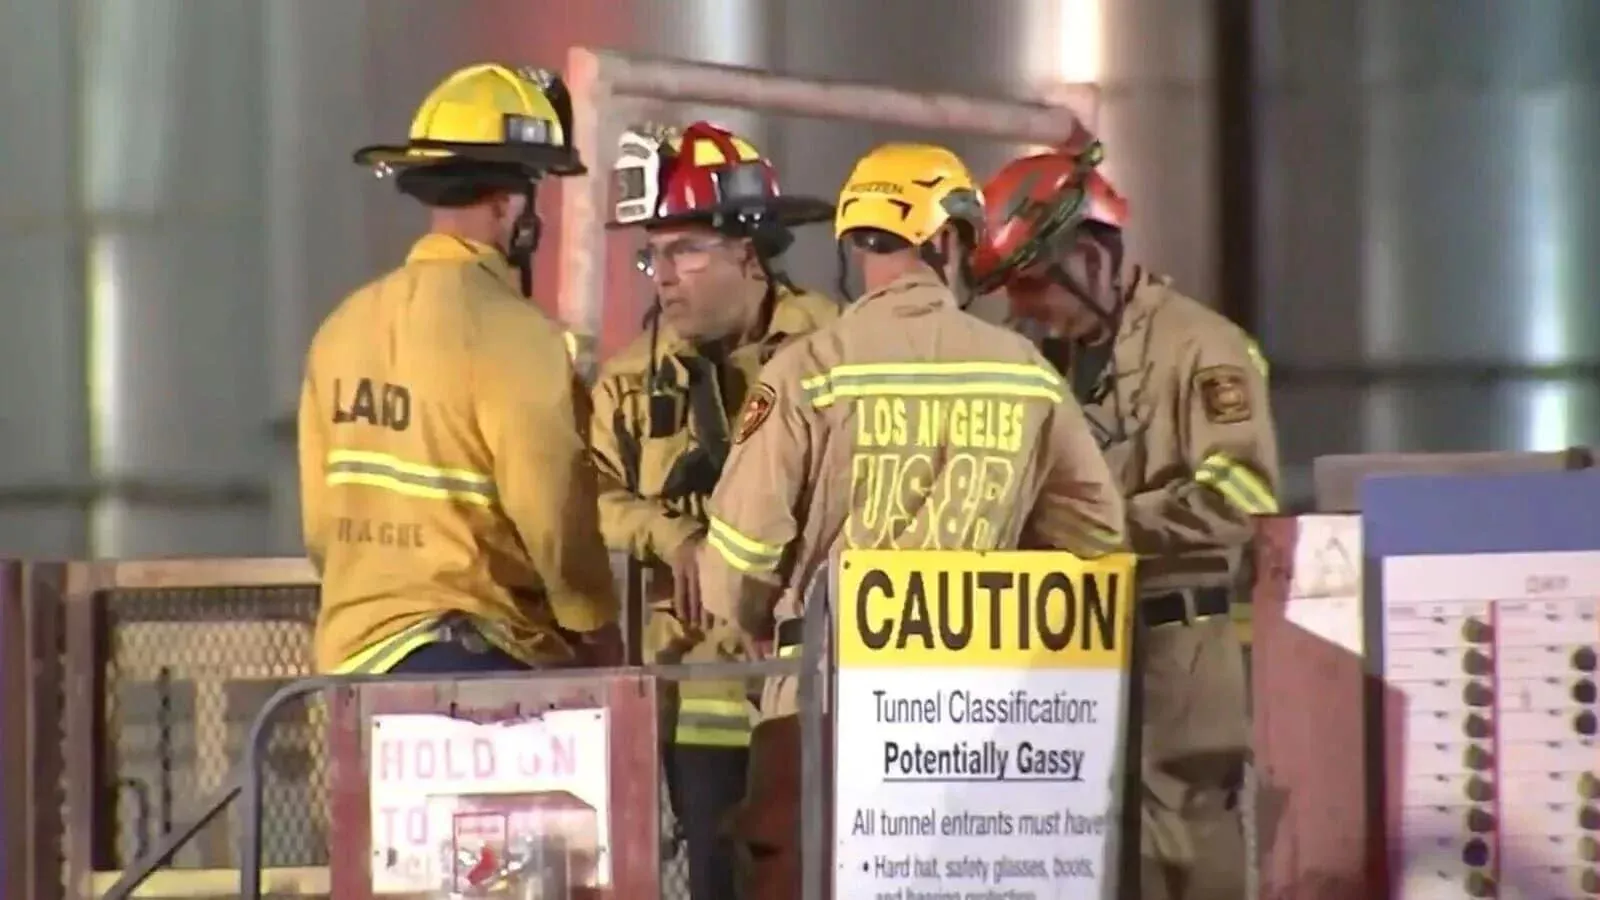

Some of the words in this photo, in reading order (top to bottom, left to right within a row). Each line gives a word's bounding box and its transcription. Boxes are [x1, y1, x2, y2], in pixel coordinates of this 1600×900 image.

[857, 398, 908, 447] LOS
[856, 569, 1119, 651] CAUTION
[873, 690, 941, 723] Tunnel
[948, 689, 1098, 724] Classification:
[380, 738, 496, 781] HOLD
[884, 741, 1008, 781] Potentially
[1016, 741, 1085, 781] Gassy
[380, 806, 428, 848] TO
[852, 808, 875, 836] All
[881, 808, 936, 836] tunnel
[941, 811, 1013, 836] entrants
[1018, 812, 1060, 836] must
[875, 855, 910, 878] Hard
[945, 856, 990, 883] safety
